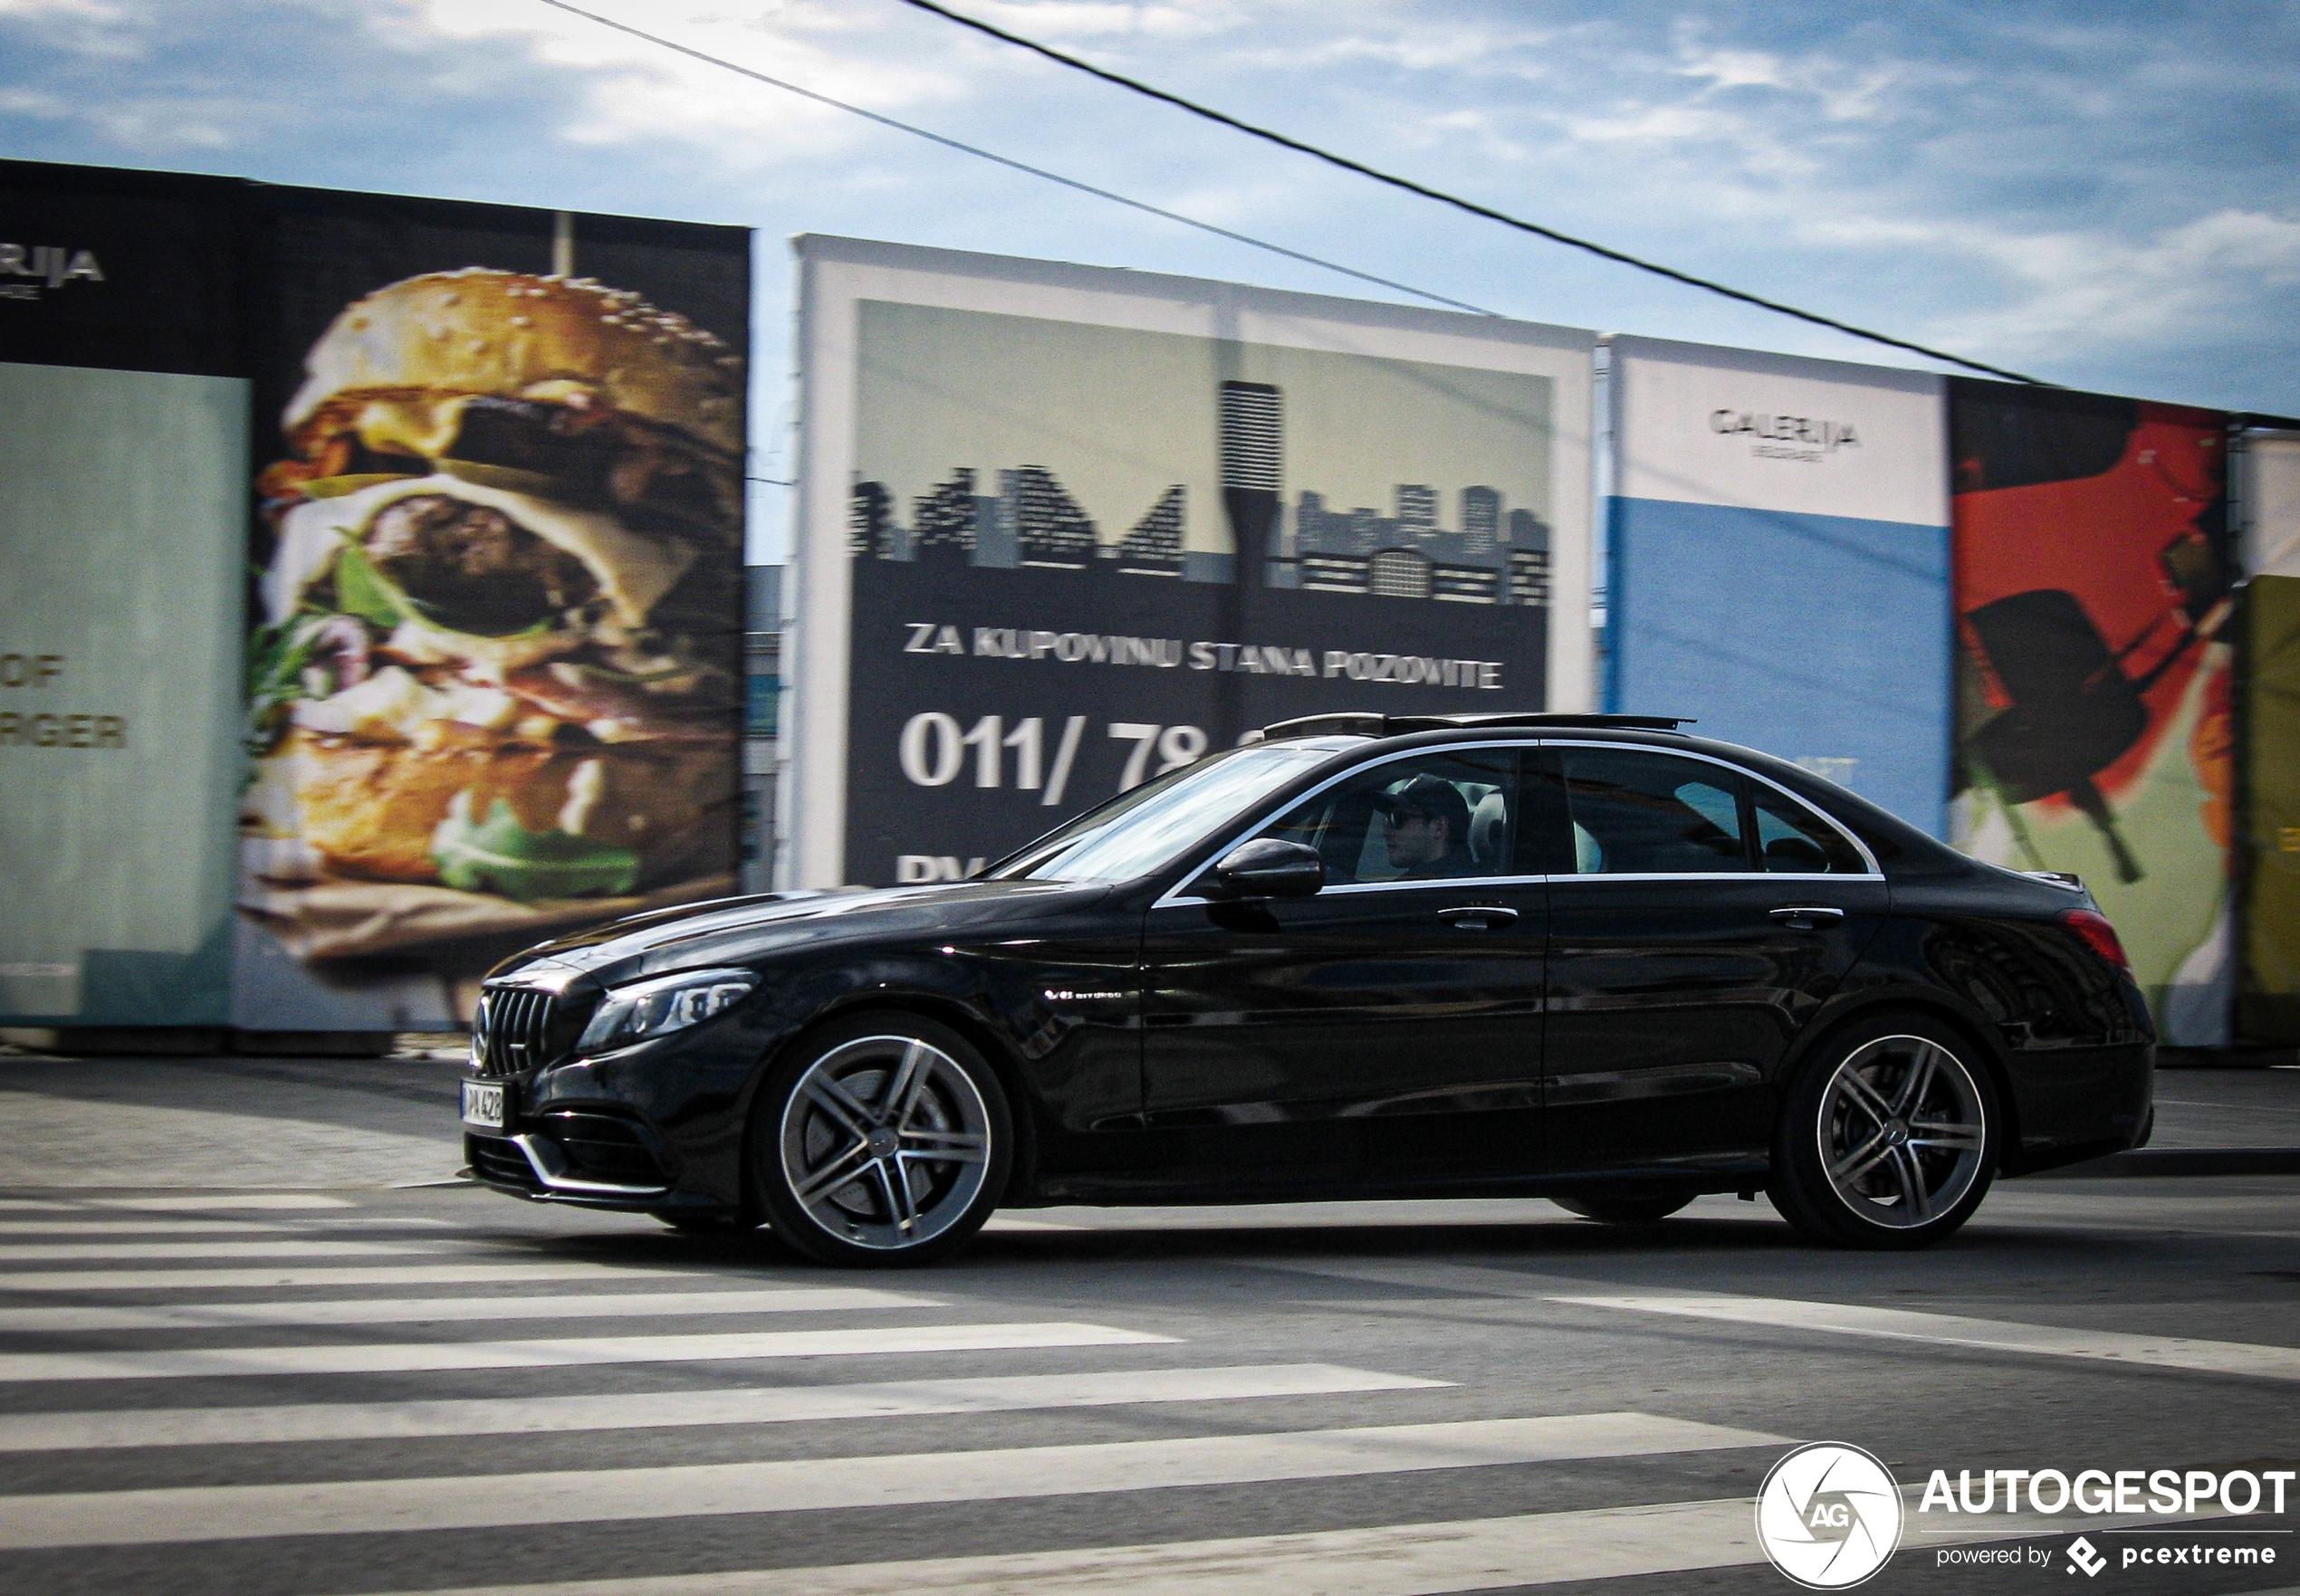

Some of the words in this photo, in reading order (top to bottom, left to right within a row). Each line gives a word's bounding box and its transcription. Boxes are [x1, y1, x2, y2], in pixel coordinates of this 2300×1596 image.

[1709, 408, 1861, 452] GALERIJA
[904, 623, 965, 655] ZA
[973, 626, 1183, 668] KUPOVINU
[1188, 641, 1317, 677] STANA
[1323, 650, 1504, 690] POZOVITE
[898, 712, 1087, 805] 011/
